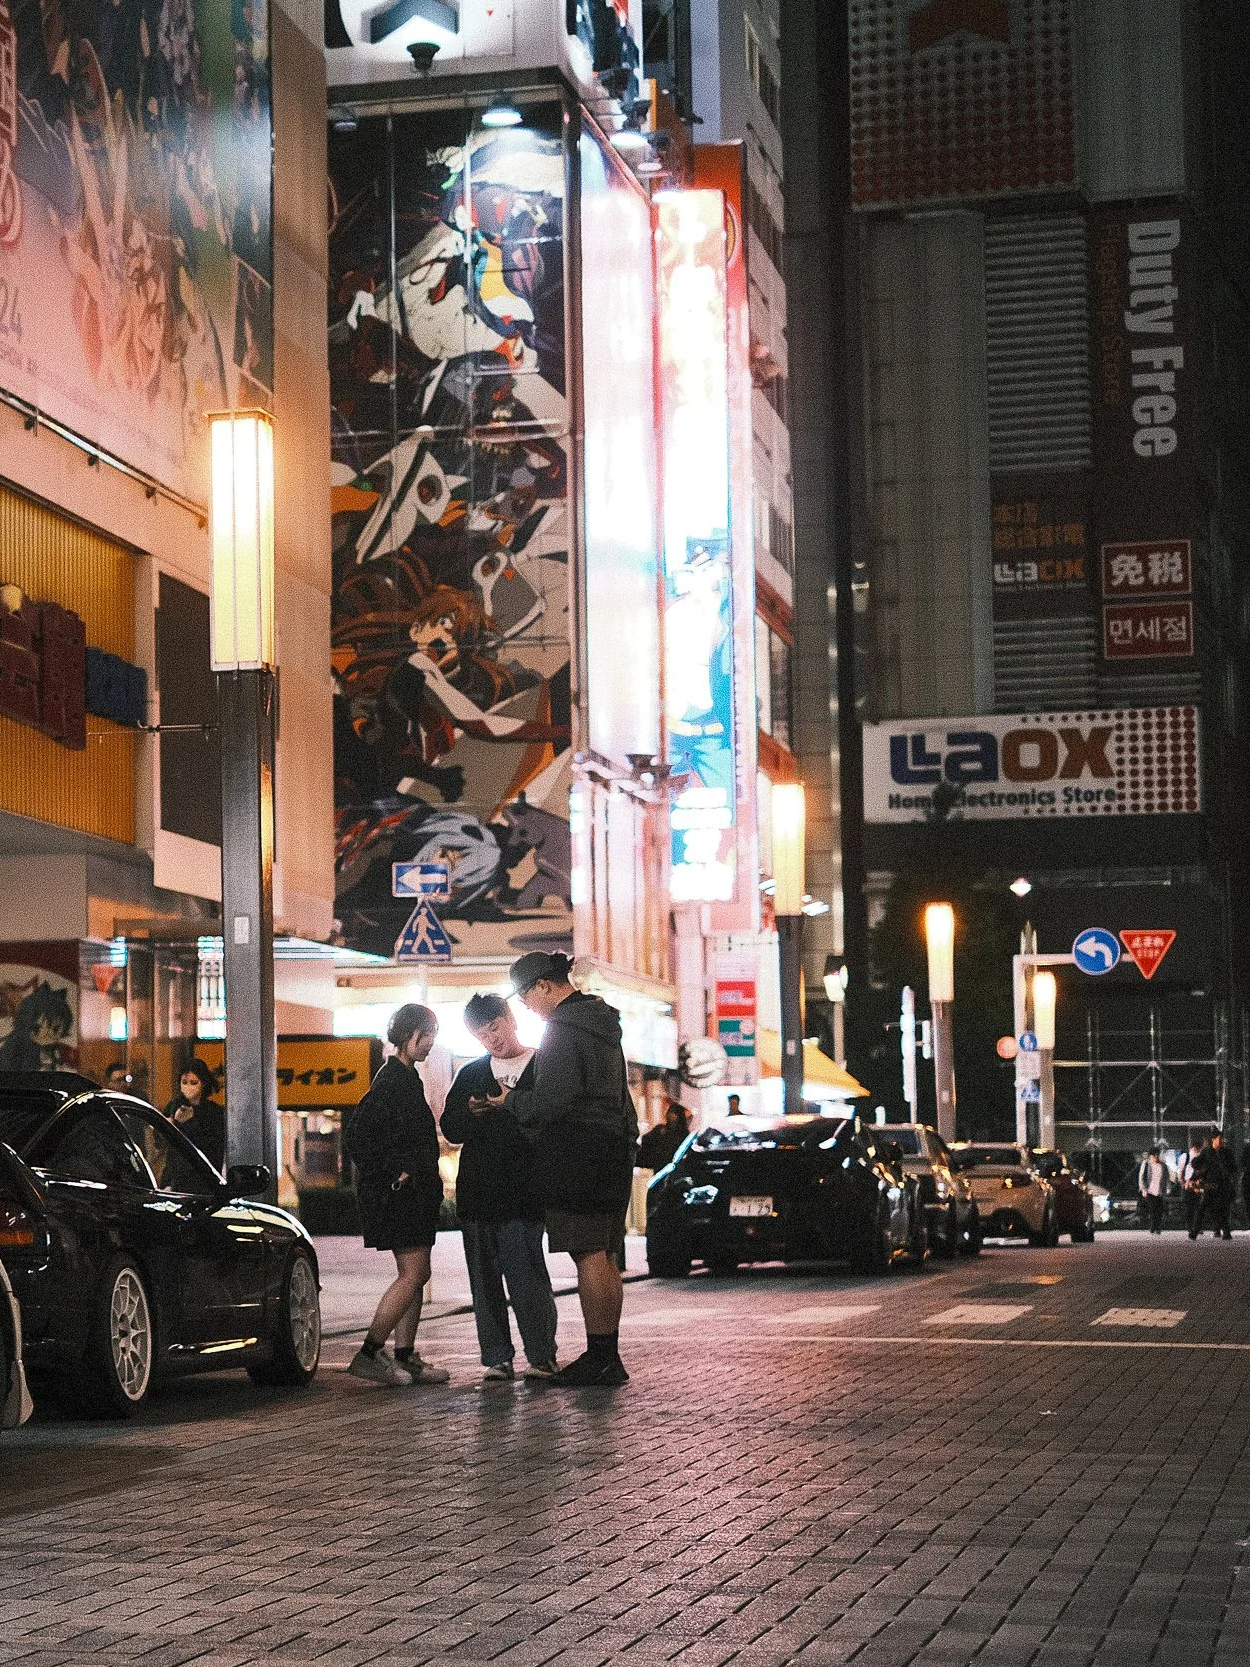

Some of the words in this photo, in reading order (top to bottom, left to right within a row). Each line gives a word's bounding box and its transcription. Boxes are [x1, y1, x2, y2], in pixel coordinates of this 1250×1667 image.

[1124, 219, 1181, 334] Duty
[1131, 346, 1185, 458] Free
[1111, 551, 1183, 587] 免税
[1109, 615, 1189, 645] 면세점
[1063, 786, 1117, 804] Store
